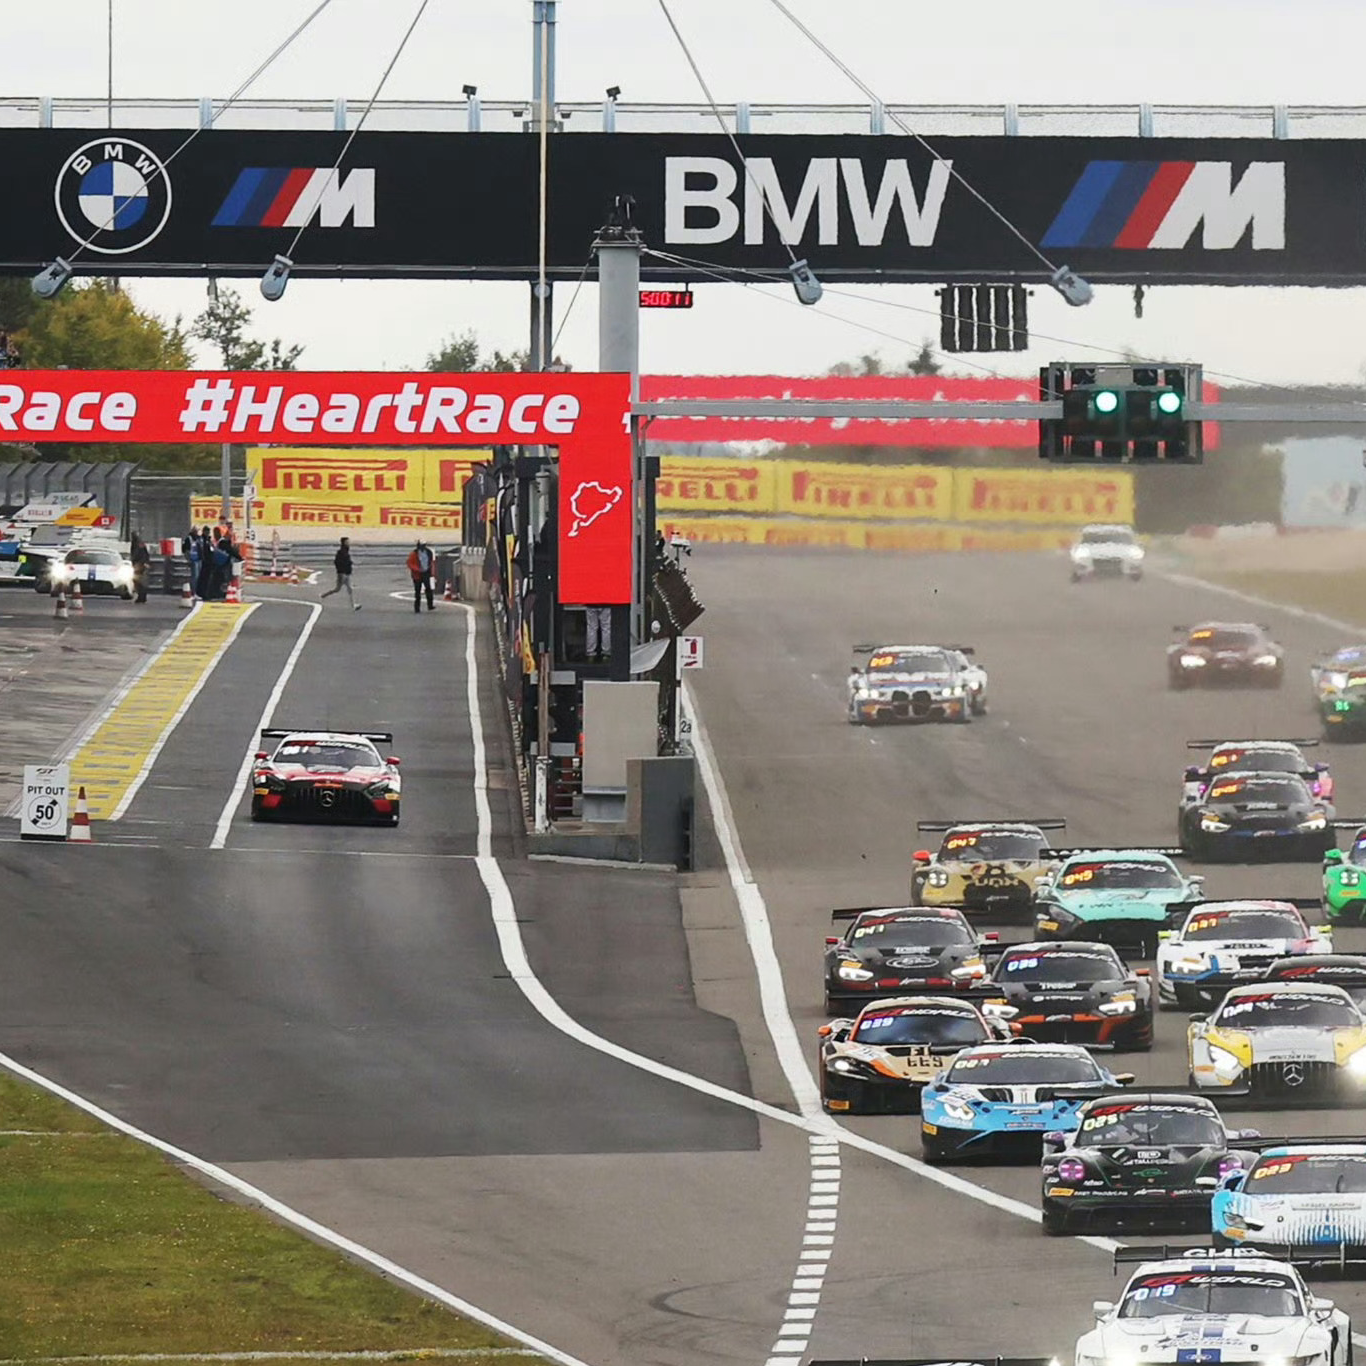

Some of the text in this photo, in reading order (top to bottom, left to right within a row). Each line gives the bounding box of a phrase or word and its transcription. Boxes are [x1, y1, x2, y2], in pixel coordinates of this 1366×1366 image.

[72, 144, 156, 175] BMW
[664, 155, 953, 248] BMW
[179, 379, 579, 433] #HeartRace
[262, 458, 408, 492] PIRELLI
[656, 464, 760, 501] RELLI
[281, 503, 364, 524] PIRELLI
[380, 506, 461, 529] PIRELLI
[680, 720, 692, 734] 2a
[27, 785, 65, 796] PIT OUT
[36, 805, 54, 820] 50
[1191, 1275, 1286, 1287] WORLD
